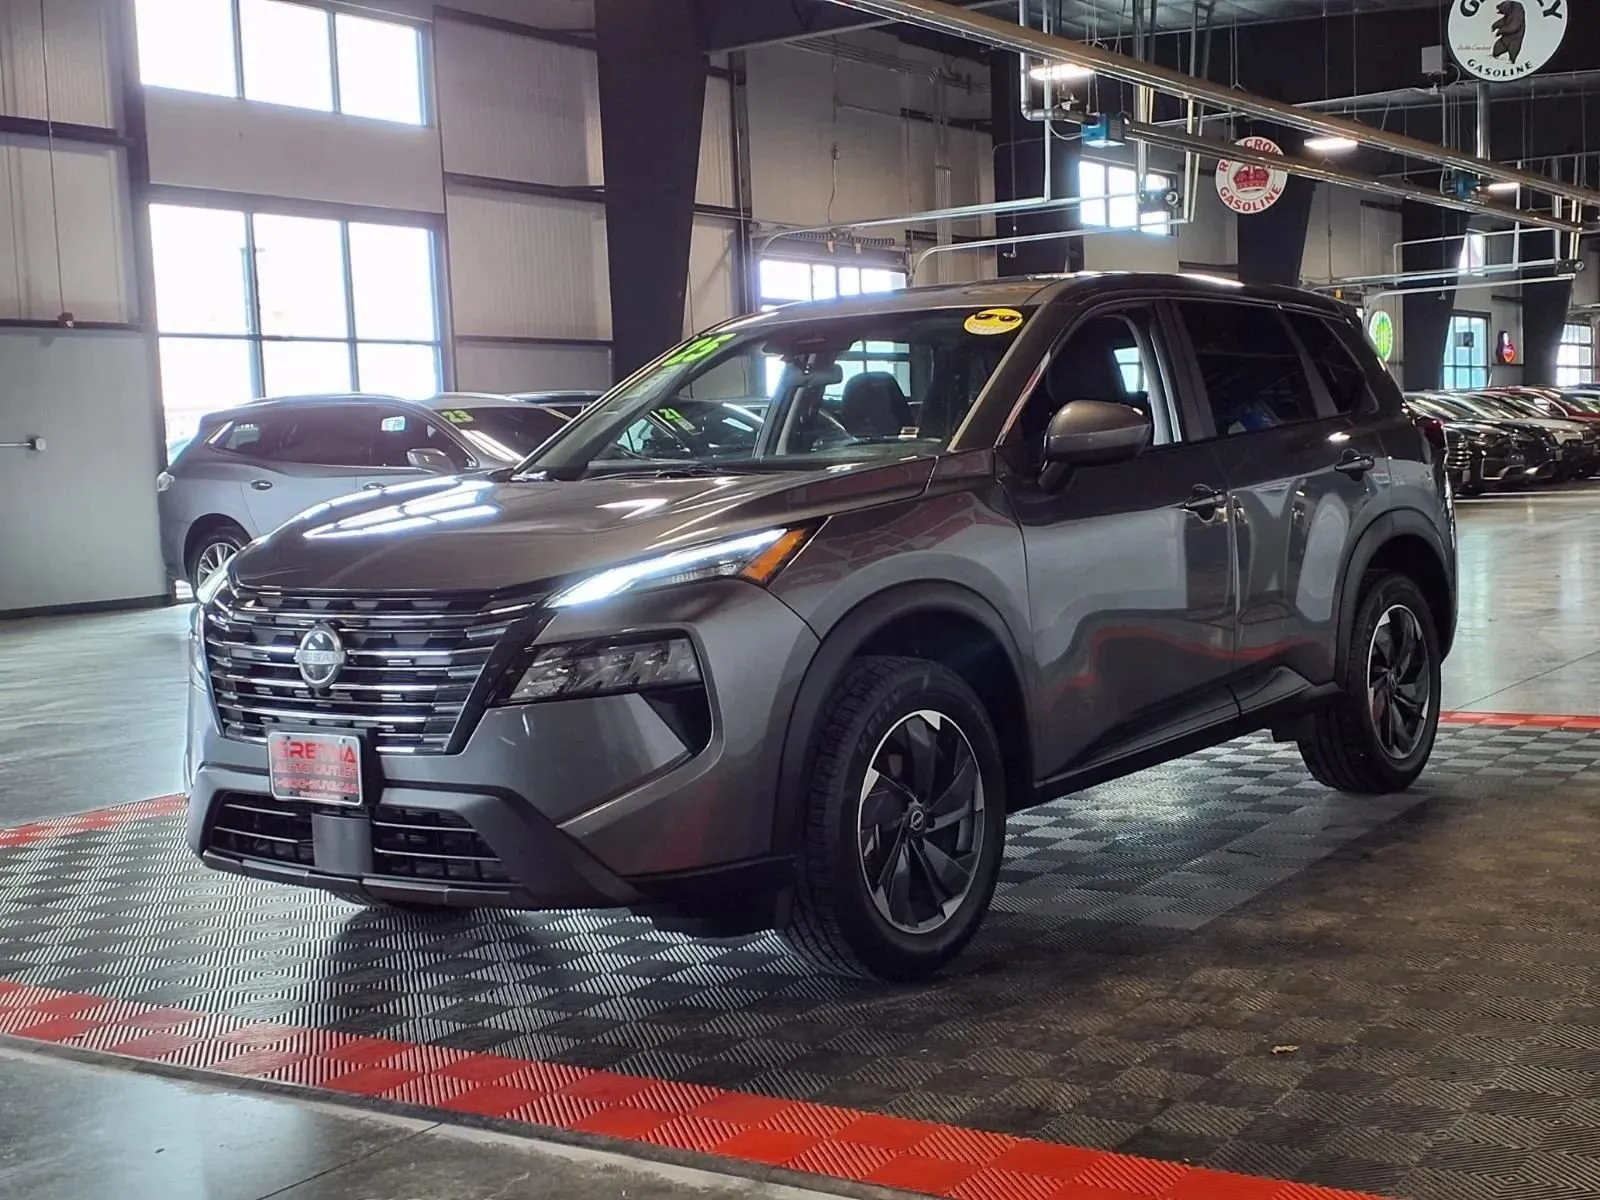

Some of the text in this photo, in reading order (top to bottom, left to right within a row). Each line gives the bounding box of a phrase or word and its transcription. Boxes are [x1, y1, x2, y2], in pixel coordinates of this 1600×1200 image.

[1467, 59, 1534, 77] GASOLINE
[1243, 139, 1280, 154] CRO
[1219, 185, 1282, 212] GASOLINE
[314, 764, 357, 778] OUTLET
